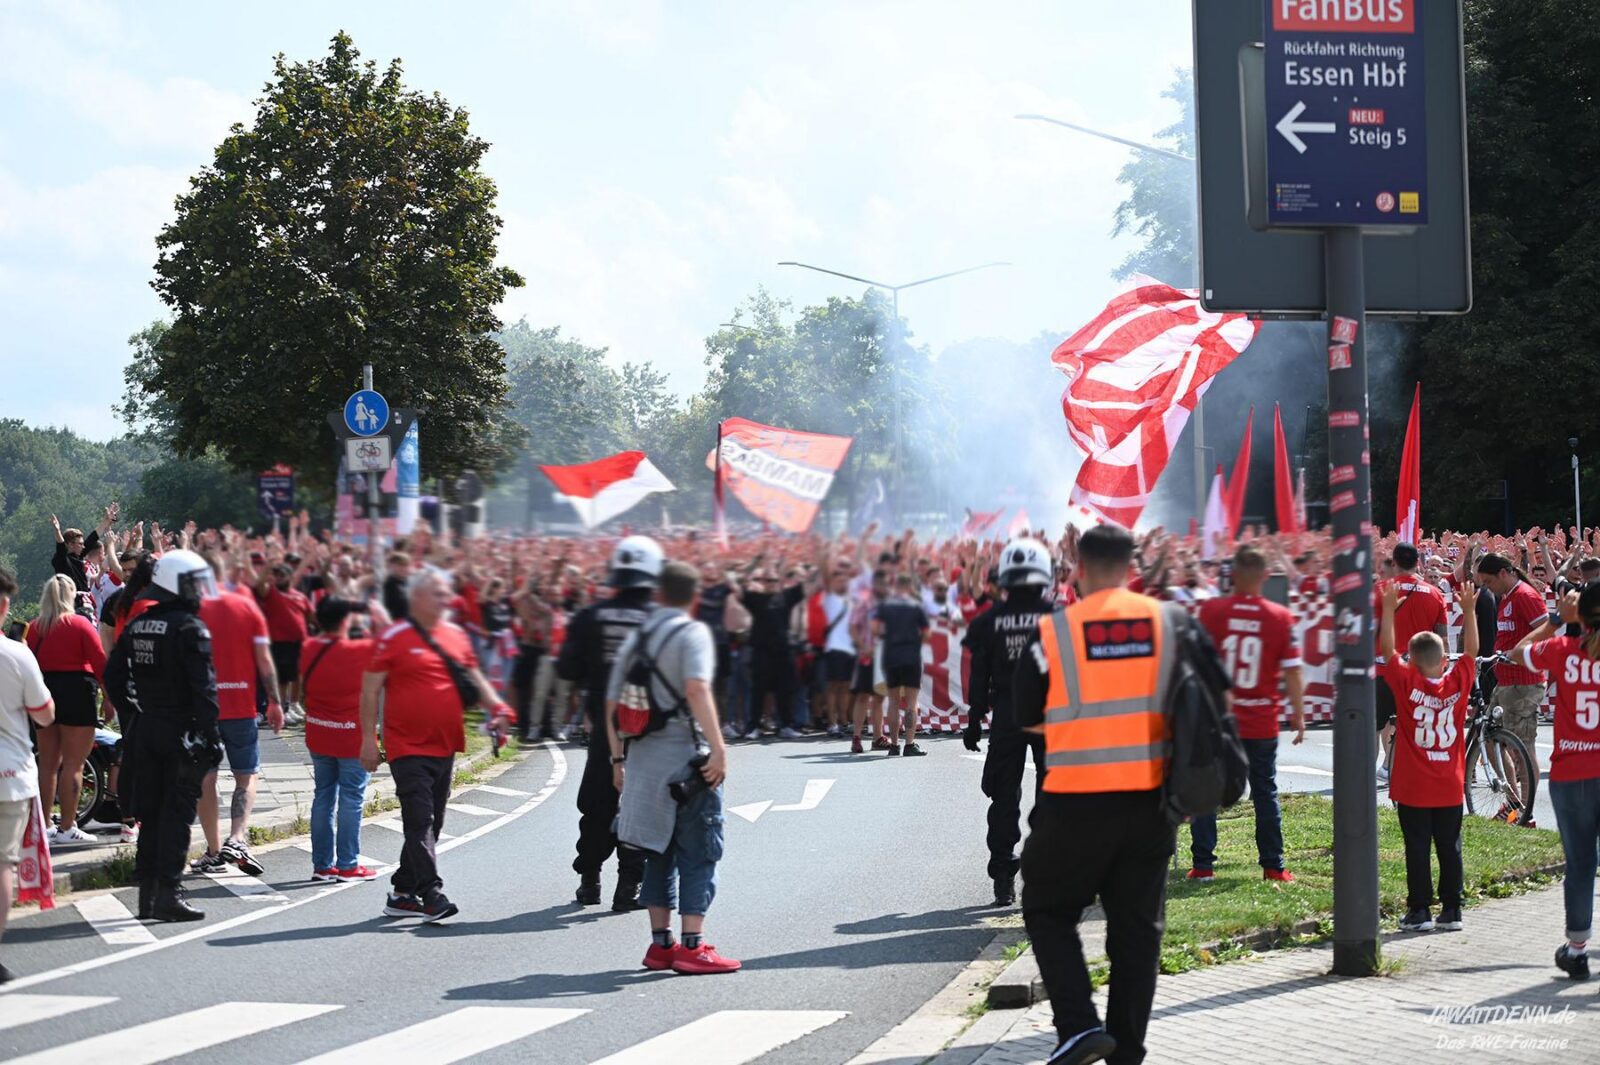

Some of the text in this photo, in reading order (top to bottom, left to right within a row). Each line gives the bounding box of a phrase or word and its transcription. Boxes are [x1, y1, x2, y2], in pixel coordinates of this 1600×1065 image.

[1282, 0, 1404, 22] FanBus
[1284, 41, 1405, 60] Rückfahrt Richtung
[1285, 61, 1407, 87] Essen Hbf
[1351, 110, 1381, 123] NEU:
[1349, 127, 1407, 149] Steig 5
[1222, 634, 1262, 689] 19
[1413, 705, 1457, 750] 30
